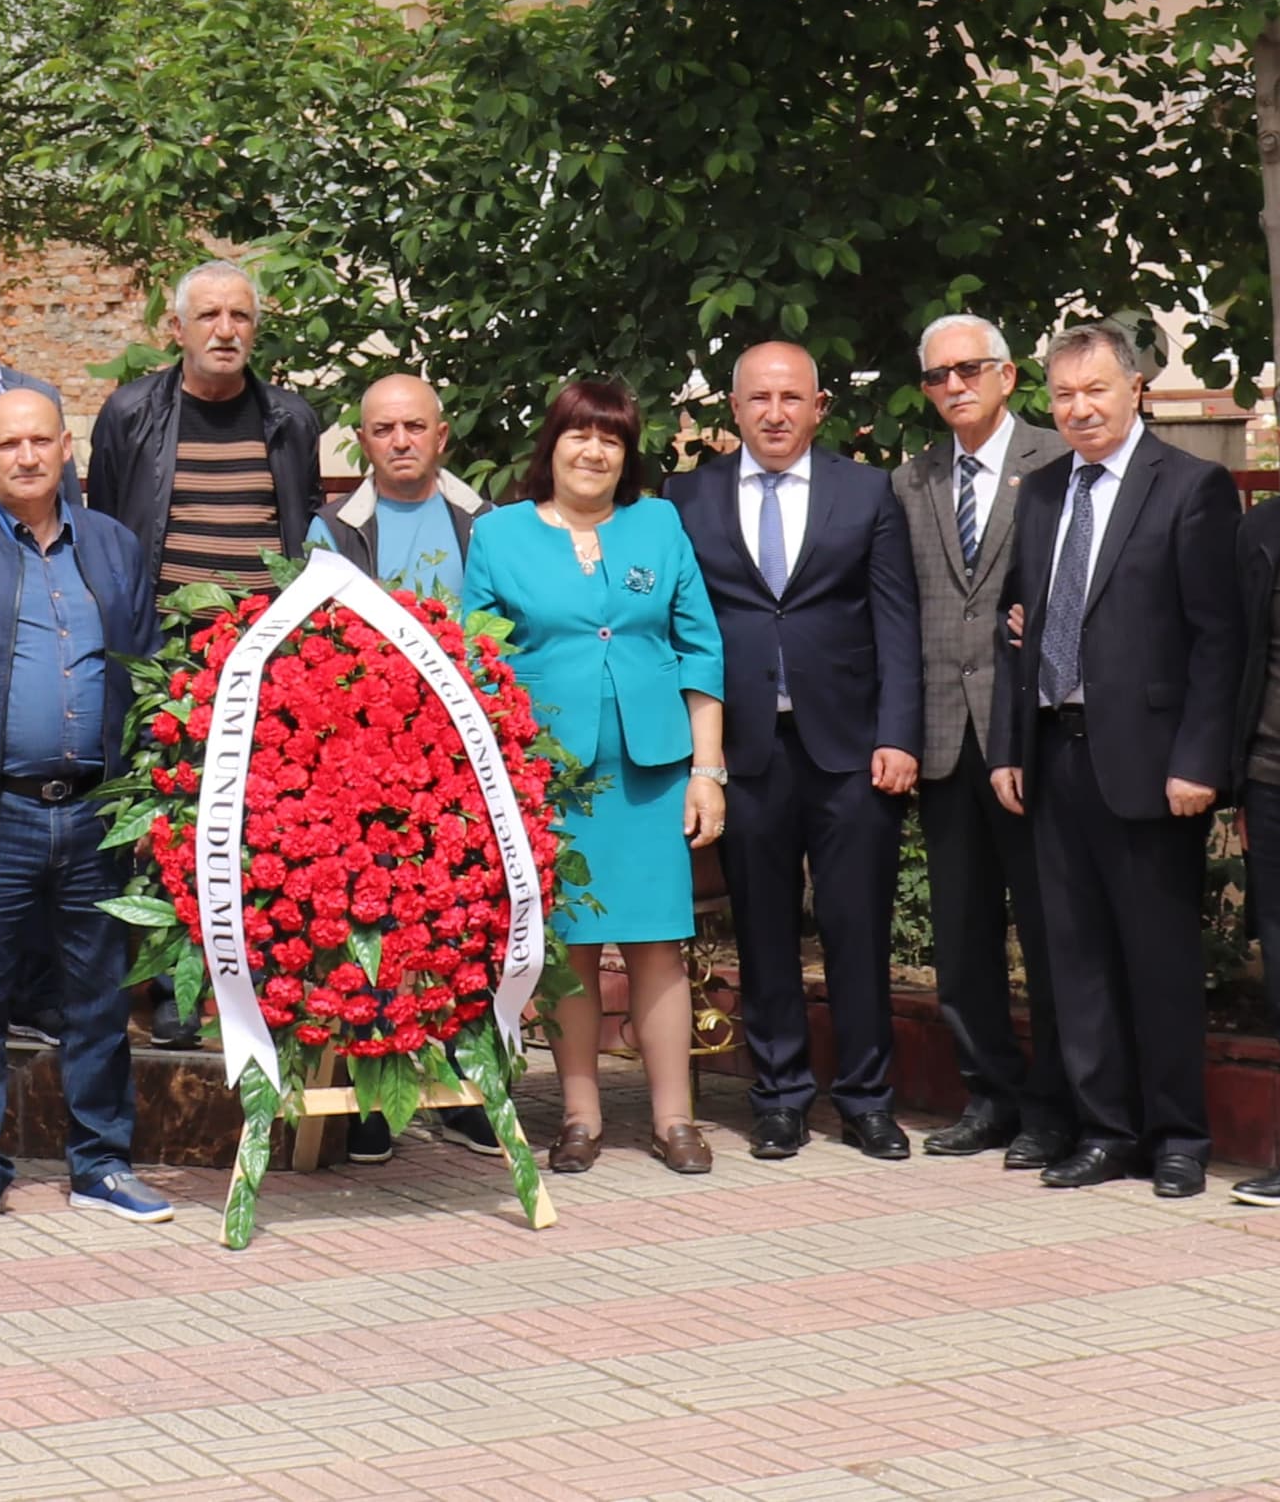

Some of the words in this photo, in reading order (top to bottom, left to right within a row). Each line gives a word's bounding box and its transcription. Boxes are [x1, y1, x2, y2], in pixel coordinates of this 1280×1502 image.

[221, 670, 254, 735] KİM
[459, 712, 503, 801] FONDU
[206, 751, 241, 977] UNUDULMUR
